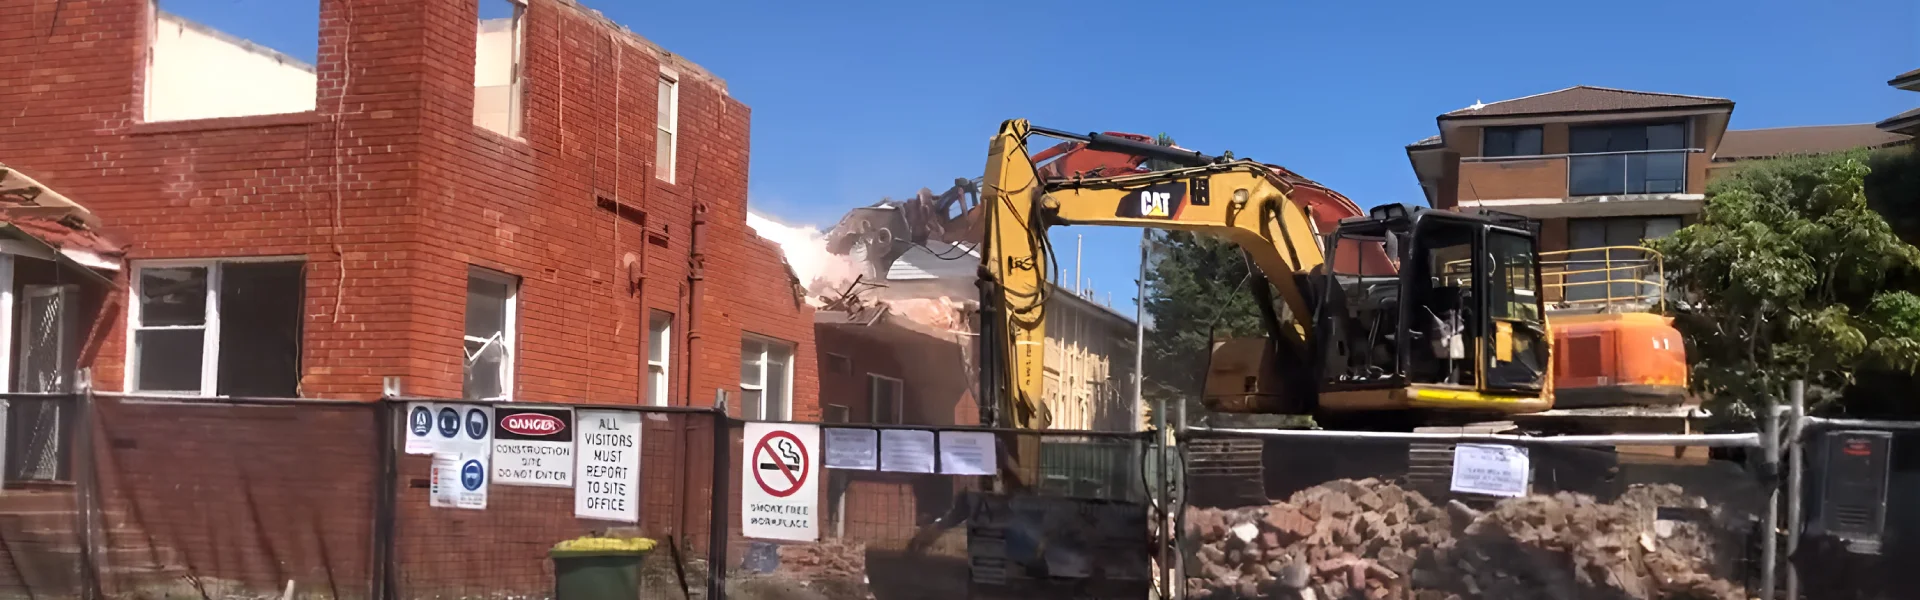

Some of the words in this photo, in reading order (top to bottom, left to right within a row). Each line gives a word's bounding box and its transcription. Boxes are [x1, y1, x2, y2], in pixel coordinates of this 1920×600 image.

[1141, 191, 1170, 216] CAT
[508, 418, 556, 431] DANGER
[599, 418, 619, 431] ALL
[585, 433, 633, 448] VISITORS
[496, 445, 570, 456] CONSTRUCTION
[594, 450, 622, 463] MUST
[499, 469, 511, 478] DO
[514, 470, 532, 479] NOT
[535, 470, 566, 480] ENTER
[586, 465, 628, 479] REPORT
[587, 481, 600, 494] TO
[602, 482, 626, 496] SITE
[587, 497, 625, 512] OFFICE
